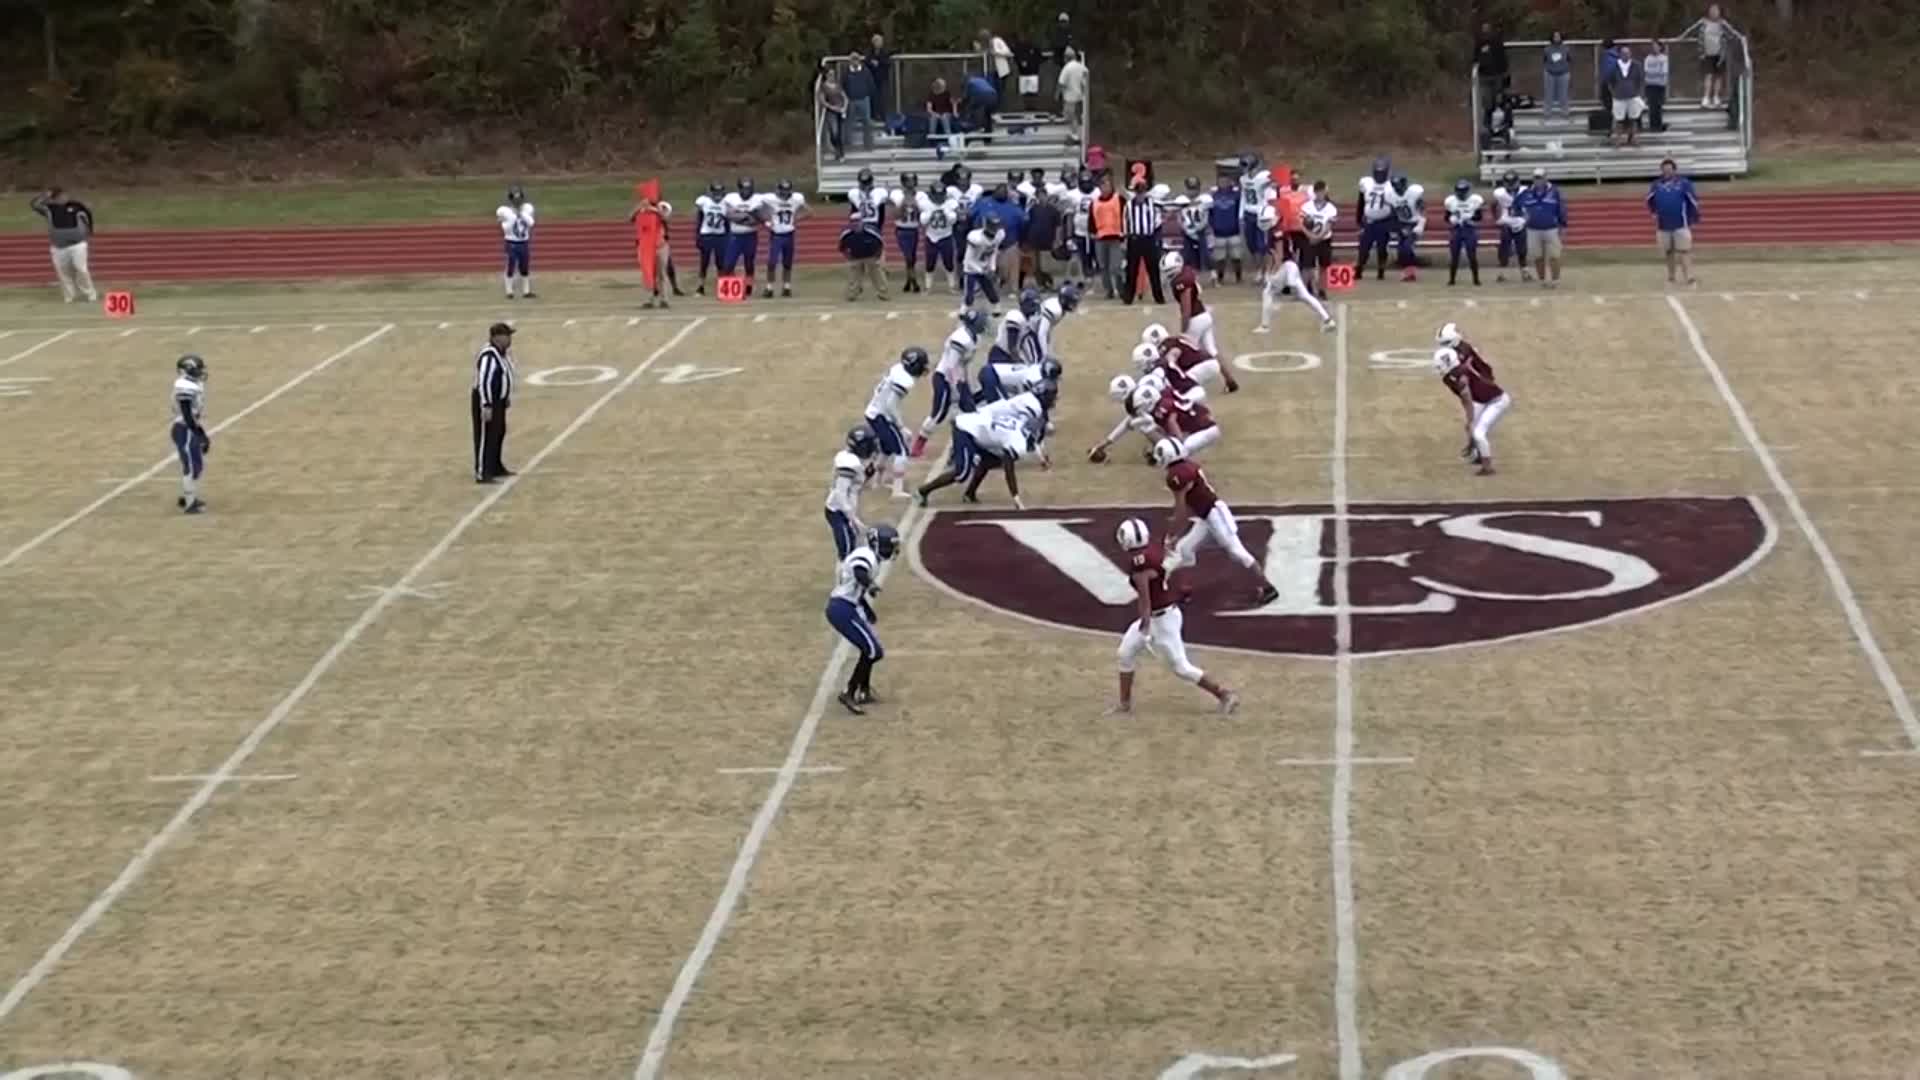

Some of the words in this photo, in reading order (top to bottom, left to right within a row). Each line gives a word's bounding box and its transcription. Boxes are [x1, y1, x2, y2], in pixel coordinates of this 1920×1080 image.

[1368, 190, 1387, 210] 71
[1329, 267, 1352, 286] 50
[719, 280, 742, 297] 40
[107, 295, 129, 313] 30
